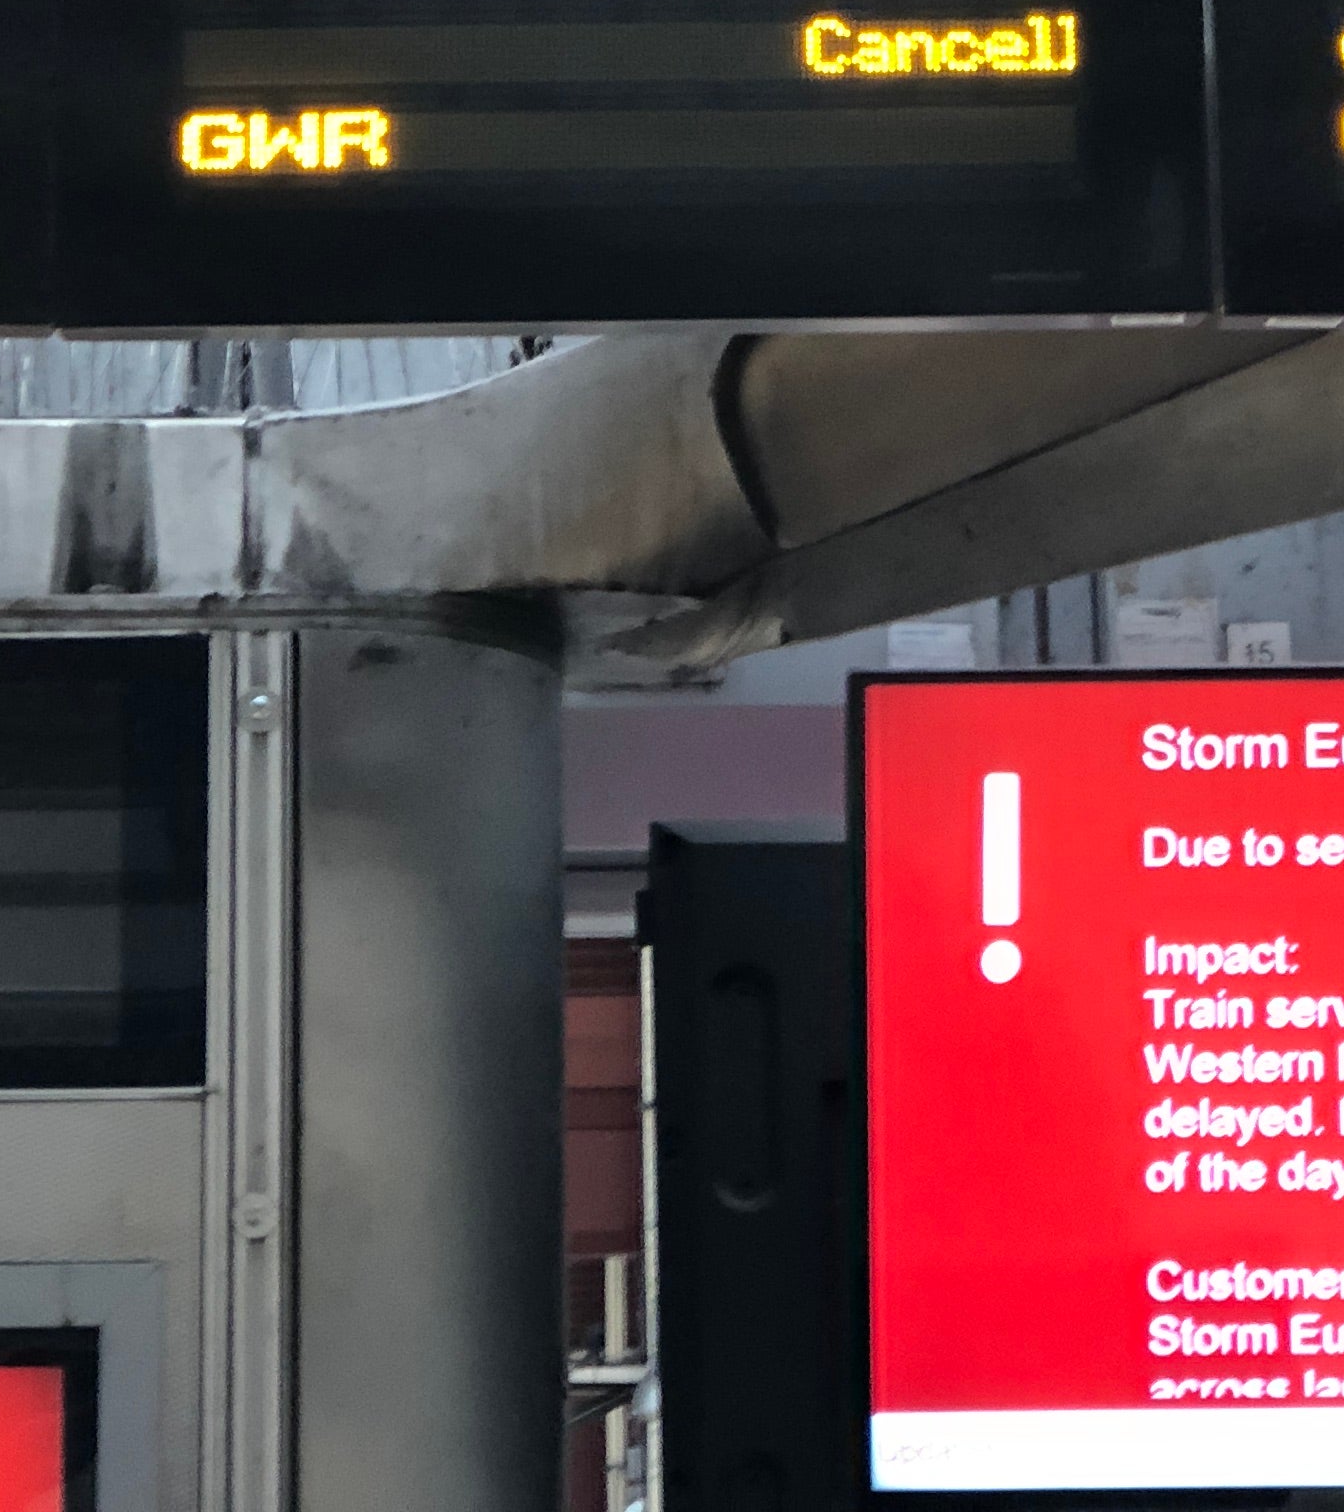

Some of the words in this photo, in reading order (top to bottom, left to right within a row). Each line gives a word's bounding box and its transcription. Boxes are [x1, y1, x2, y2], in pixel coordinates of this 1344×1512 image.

[179, 107, 392, 173] GWR
[1141, 722, 1289, 772] Storm
[1142, 825, 1232, 869] Due
[1241, 827, 1286, 868] to
[1144, 934, 1300, 985] Impact:
[1142, 987, 1255, 1031] Train
[1142, 1042, 1326, 1085] Western
[1143, 1095, 1326, 1148] delayed.
[1144, 1150, 1191, 1194] of
[1196, 1150, 1269, 1193] the
[1147, 1313, 1279, 1357] Storm
